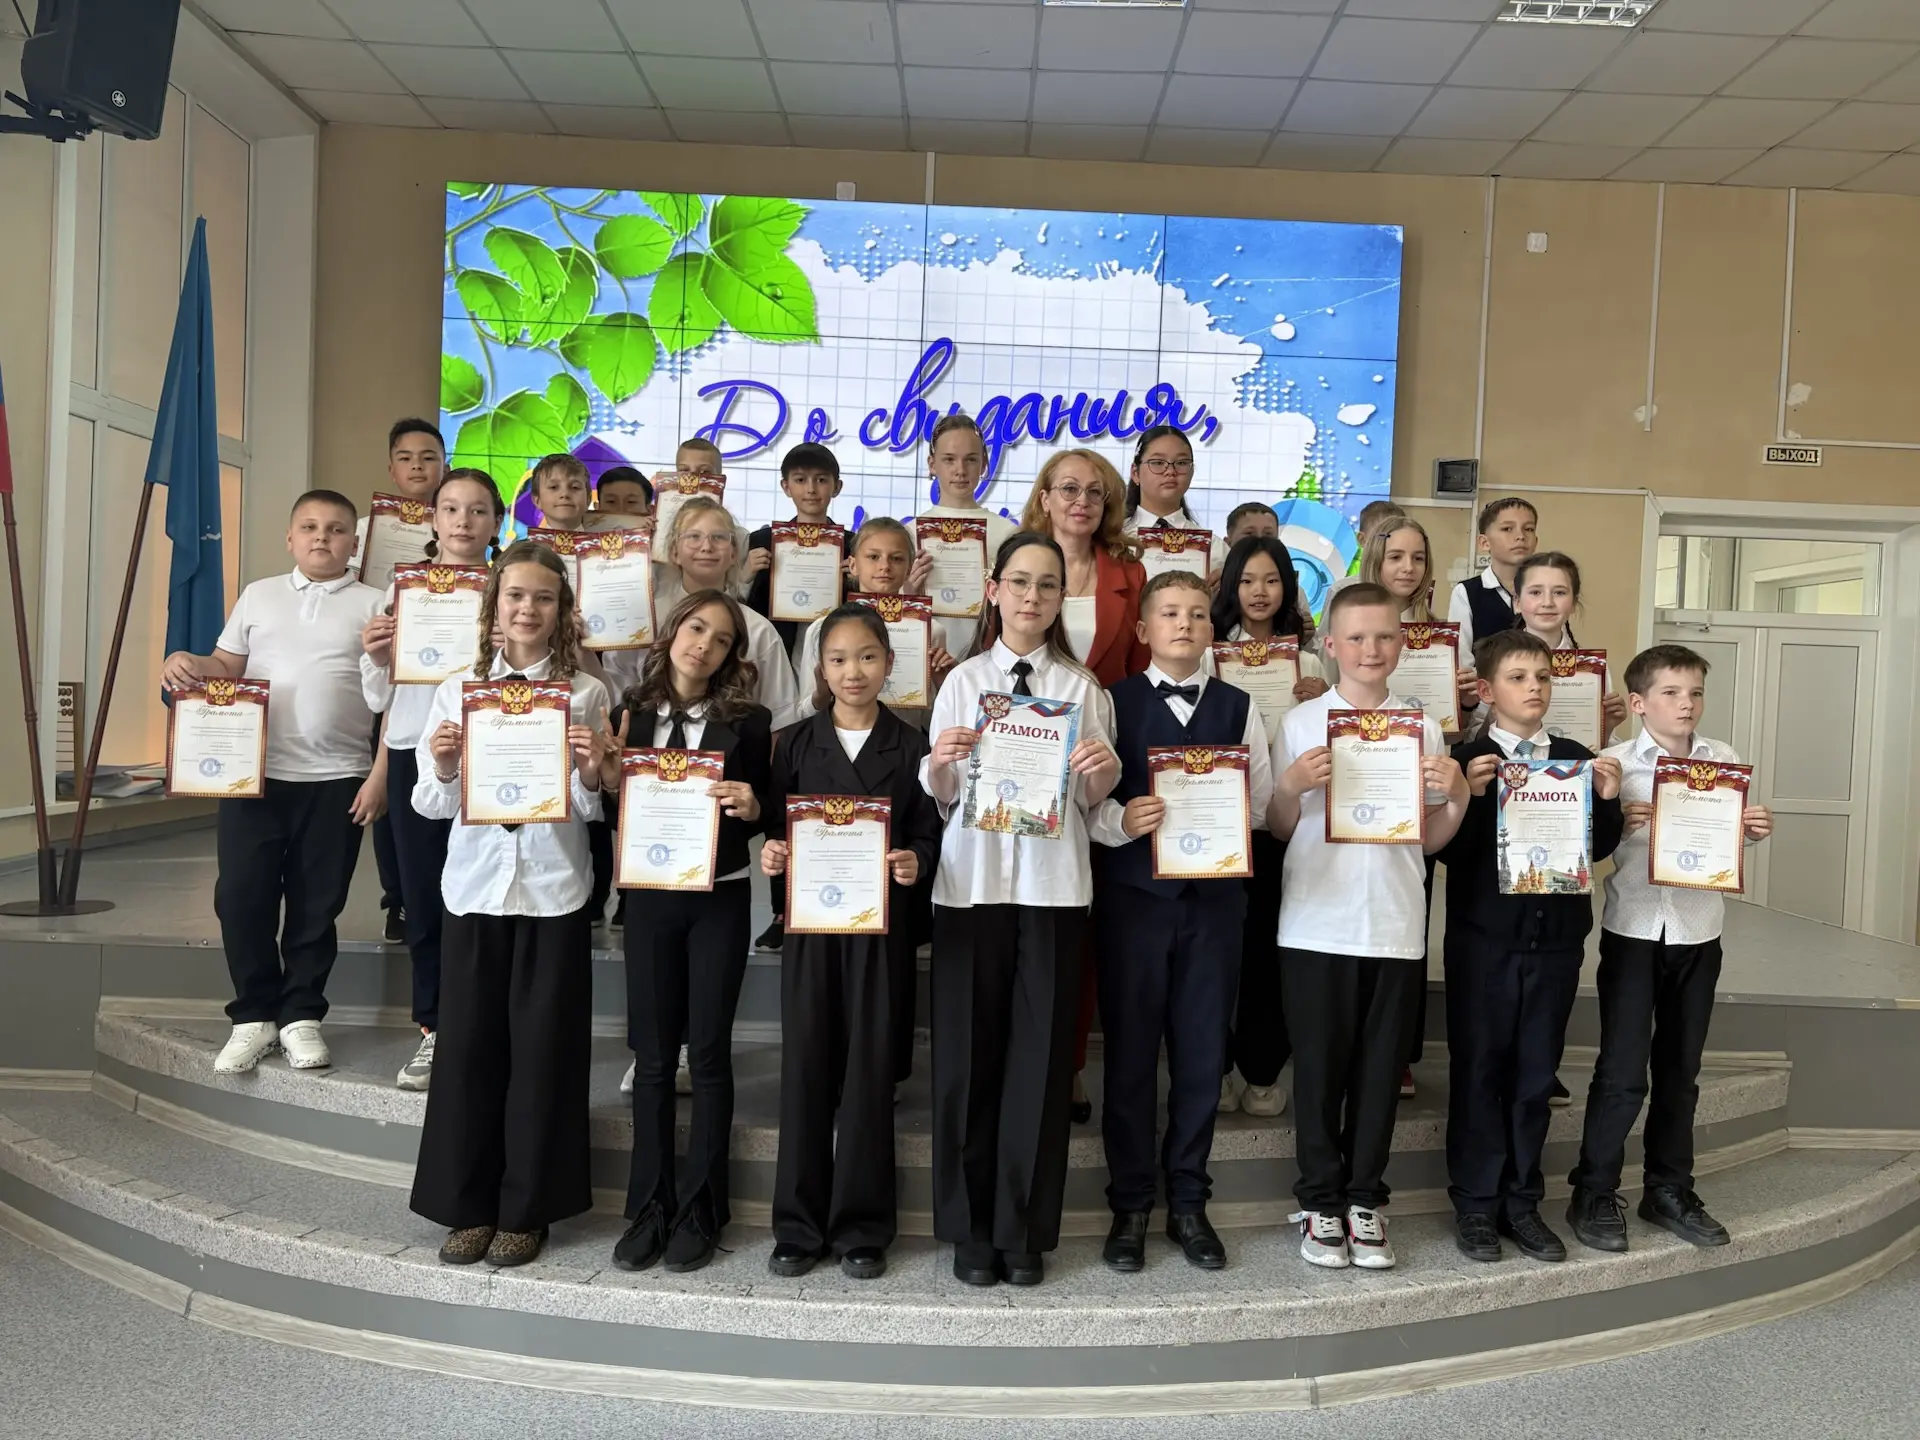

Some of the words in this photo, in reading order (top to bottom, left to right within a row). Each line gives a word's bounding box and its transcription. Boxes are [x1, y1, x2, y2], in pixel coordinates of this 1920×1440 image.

[694, 379, 838, 458] До
[1768, 448, 1816, 462] ВЫХОД
[489, 714, 543, 730] Грамота
[990, 721, 1061, 741] ГРАМОТА
[1350, 741, 1398, 755] Грамота
[1174, 774, 1224, 790] Грамота
[1513, 791, 1579, 803] ГРАМОТА
[1676, 788, 1723, 804] Грамота
